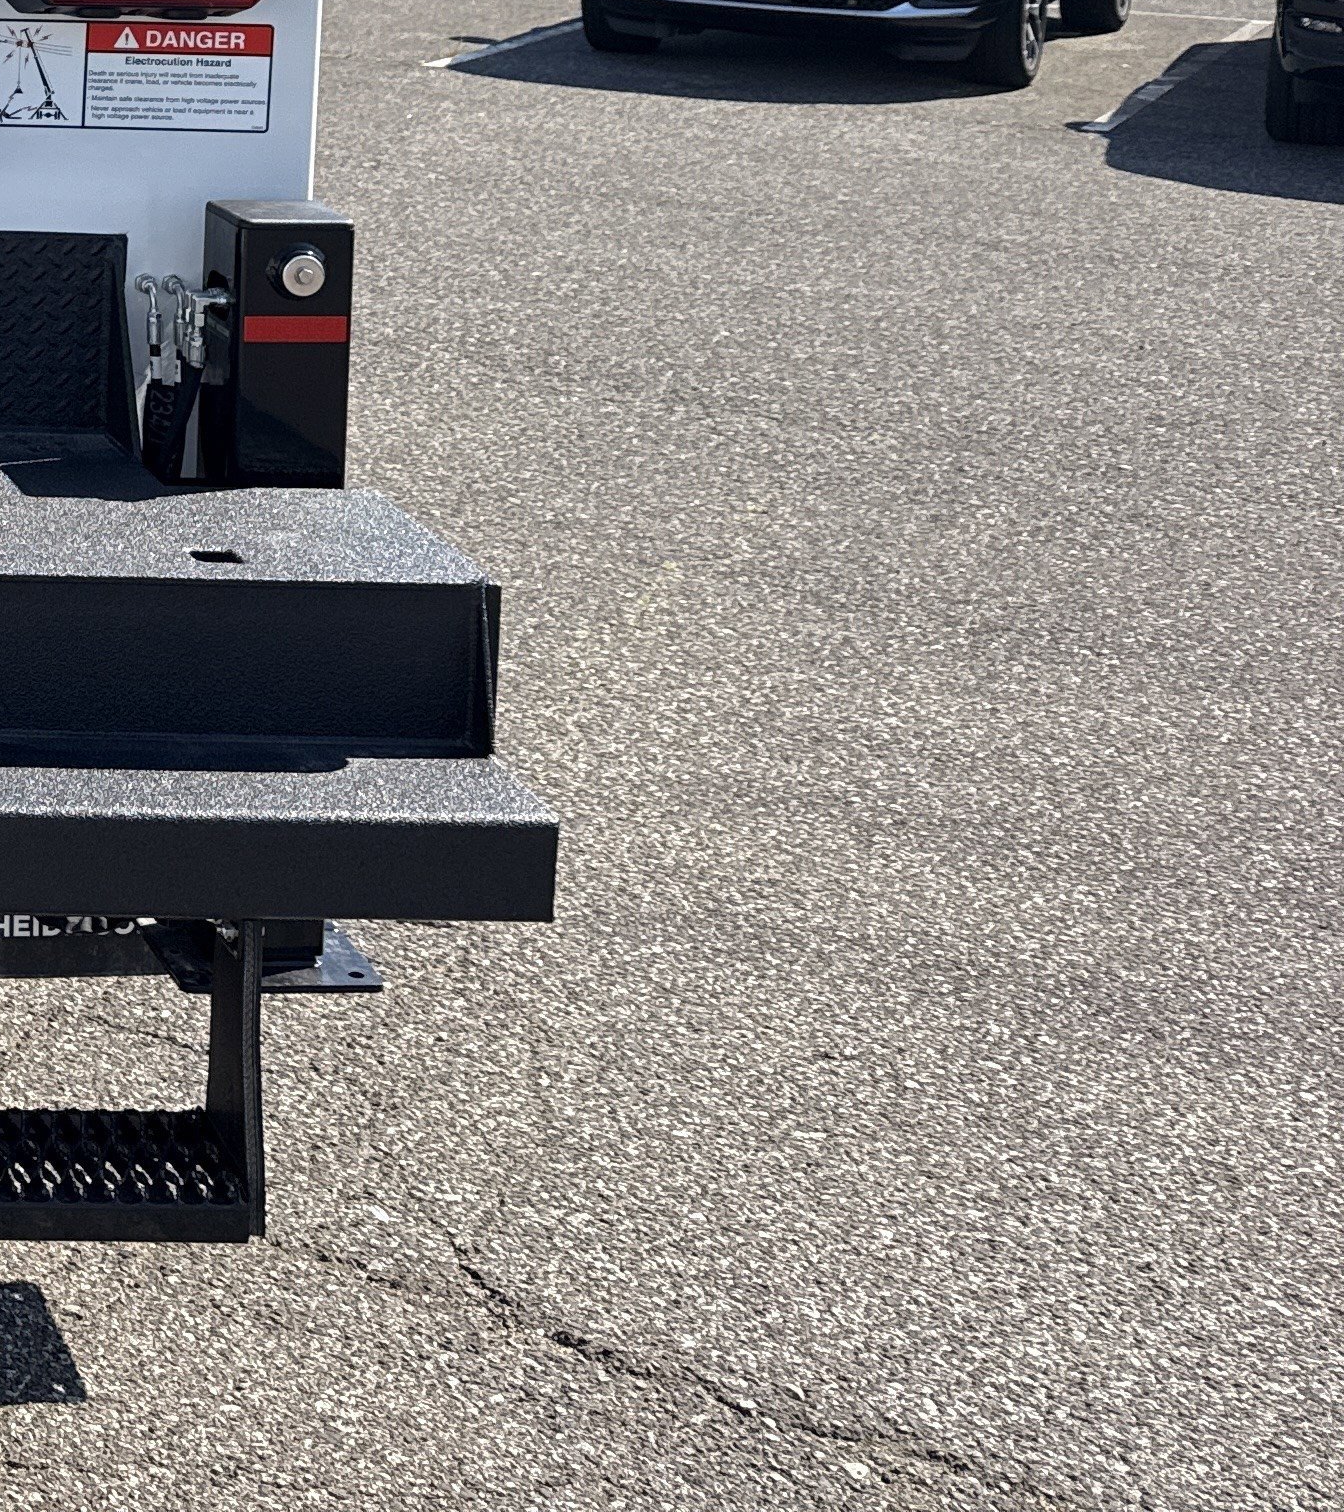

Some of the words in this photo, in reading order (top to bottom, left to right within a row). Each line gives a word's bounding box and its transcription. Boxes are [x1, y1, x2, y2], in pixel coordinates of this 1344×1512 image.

[145, 30, 246, 50] DANGER
[124, 56, 193, 67] Electrocution
[195, 57, 232, 68] Hazard
